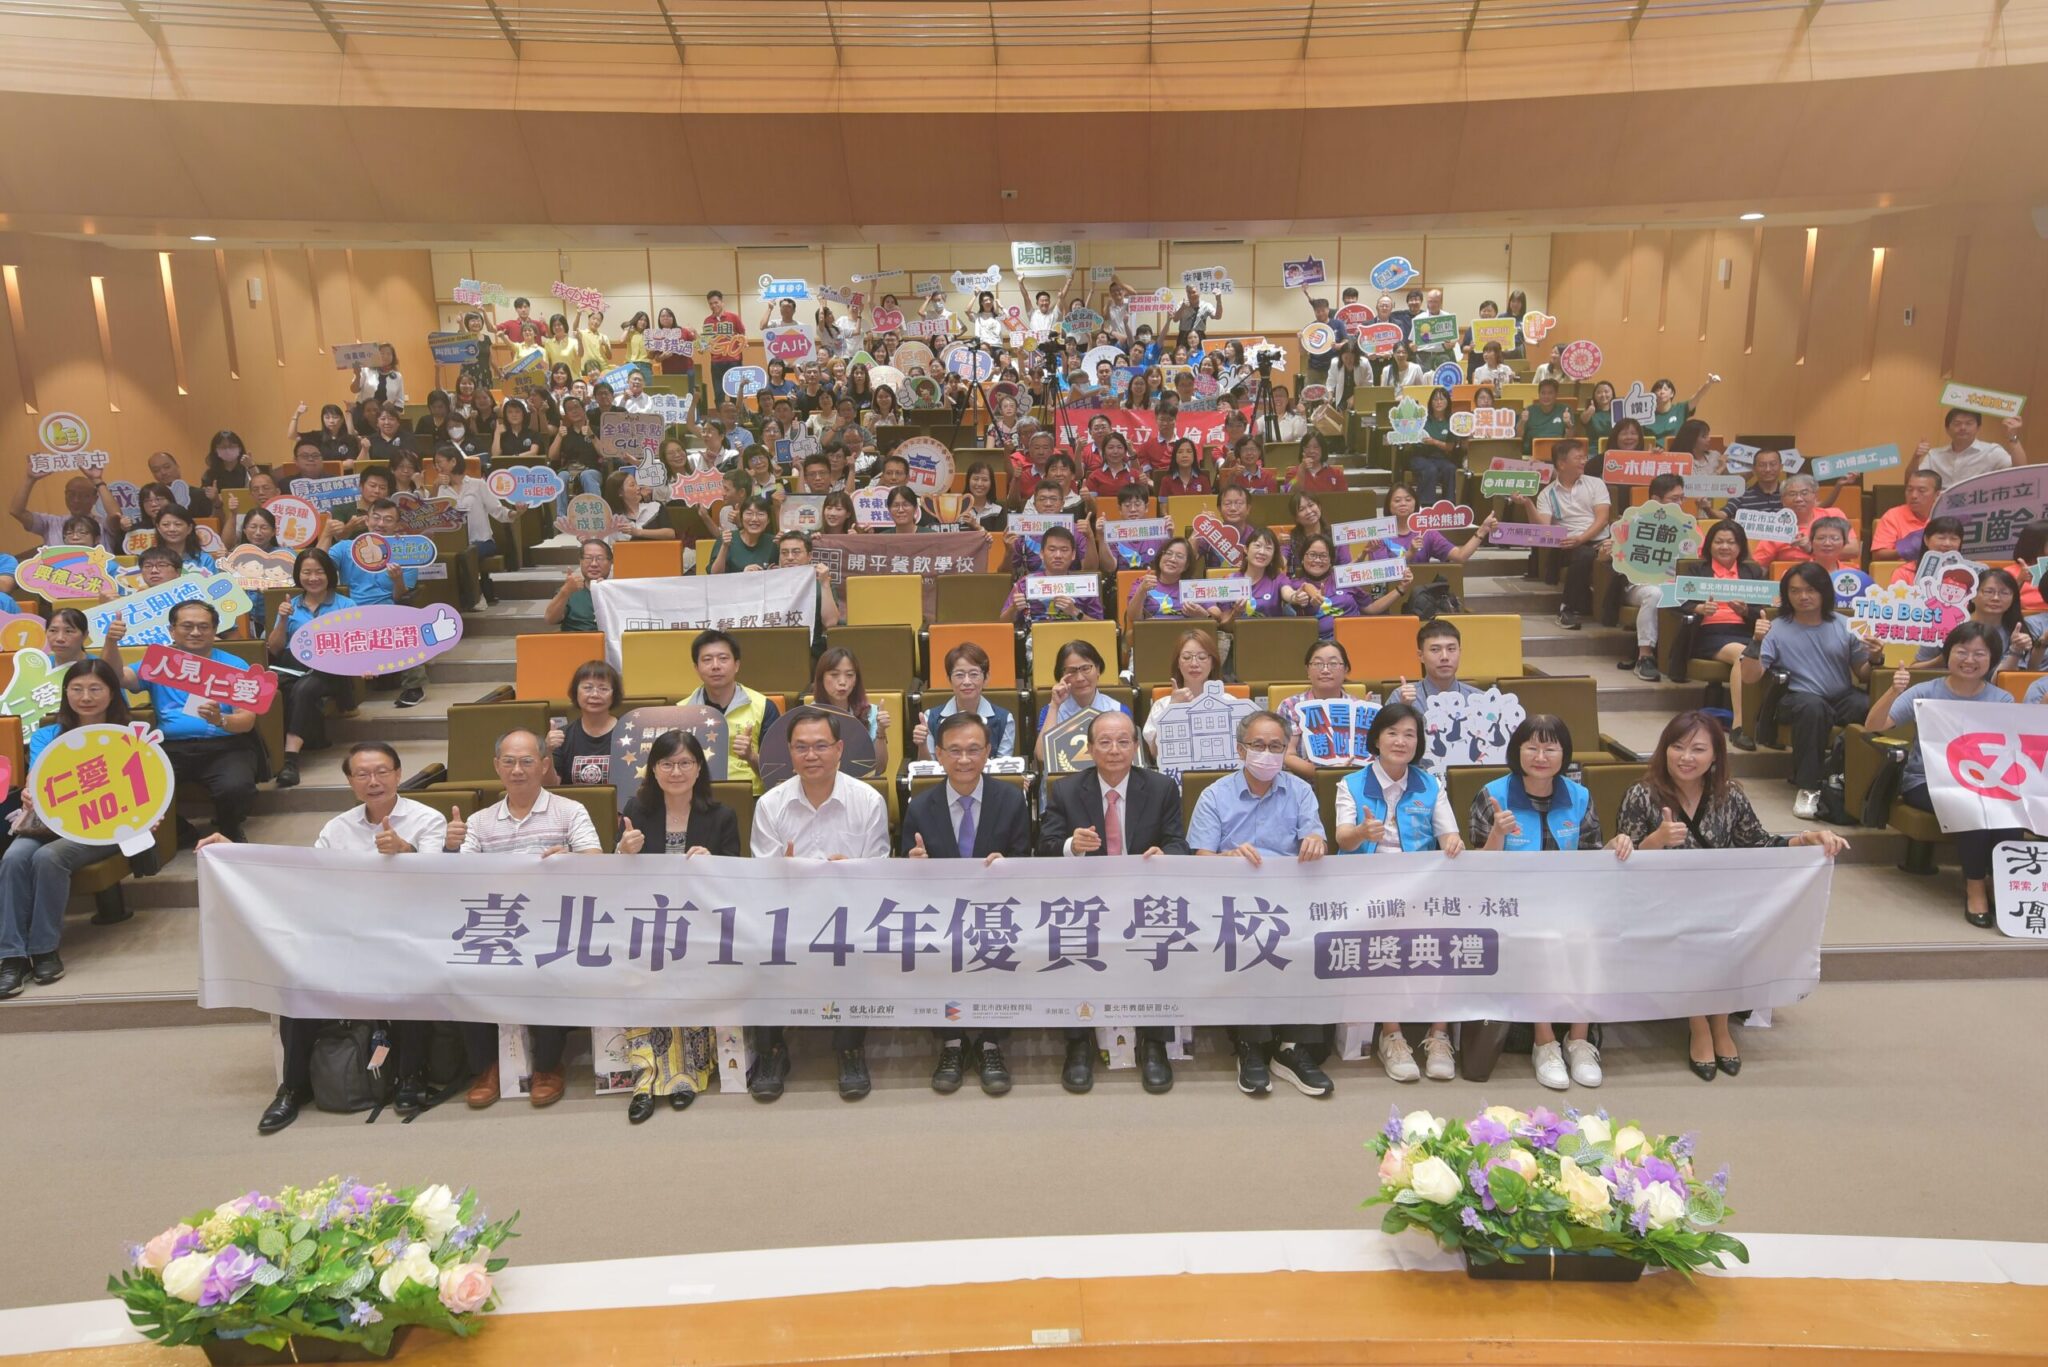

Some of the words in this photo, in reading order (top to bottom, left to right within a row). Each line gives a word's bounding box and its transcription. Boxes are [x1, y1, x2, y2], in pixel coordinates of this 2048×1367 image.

[1018, 246, 1051, 264] 陽明
[644, 338, 694, 358] 不要錯過
[770, 335, 809, 354] CAJH
[33, 452, 107, 472] 育成高中
[1623, 459, 1692, 476] 木柵高工
[1494, 479, 1537, 489] 木柵高工
[1947, 483, 2034, 509] 臺北市立
[1416, 511, 1466, 528] 西松熊讚
[1117, 526, 1168, 540] 西松熊讚!!
[1198, 518, 1241, 561] 刮目相看
[1346, 523, 1396, 540] 西松第一!!
[1635, 521, 1679, 544] 百齡
[847, 553, 975, 573] 開平餐飲學校
[1630, 543, 1673, 567] 高中
[33, 564, 103, 593] 興德之光
[1350, 563, 1405, 582] 西松熊讚!!
[1041, 582, 1096, 594] 西松第一!!
[1194, 586, 1250, 599] 西松第一!!
[1856, 600, 1893, 620] The
[1897, 603, 1943, 623] Best
[316, 625, 419, 655] 興德超讚
[150, 656, 261, 704] 人見仁愛
[44, 754, 111, 808] 仁愛
[446, 893, 1294, 974] 臺北市114年優質學校
[1328, 933, 1487, 972] 頒獎典禮
[850, 1004, 895, 1014] 臺北市政府
